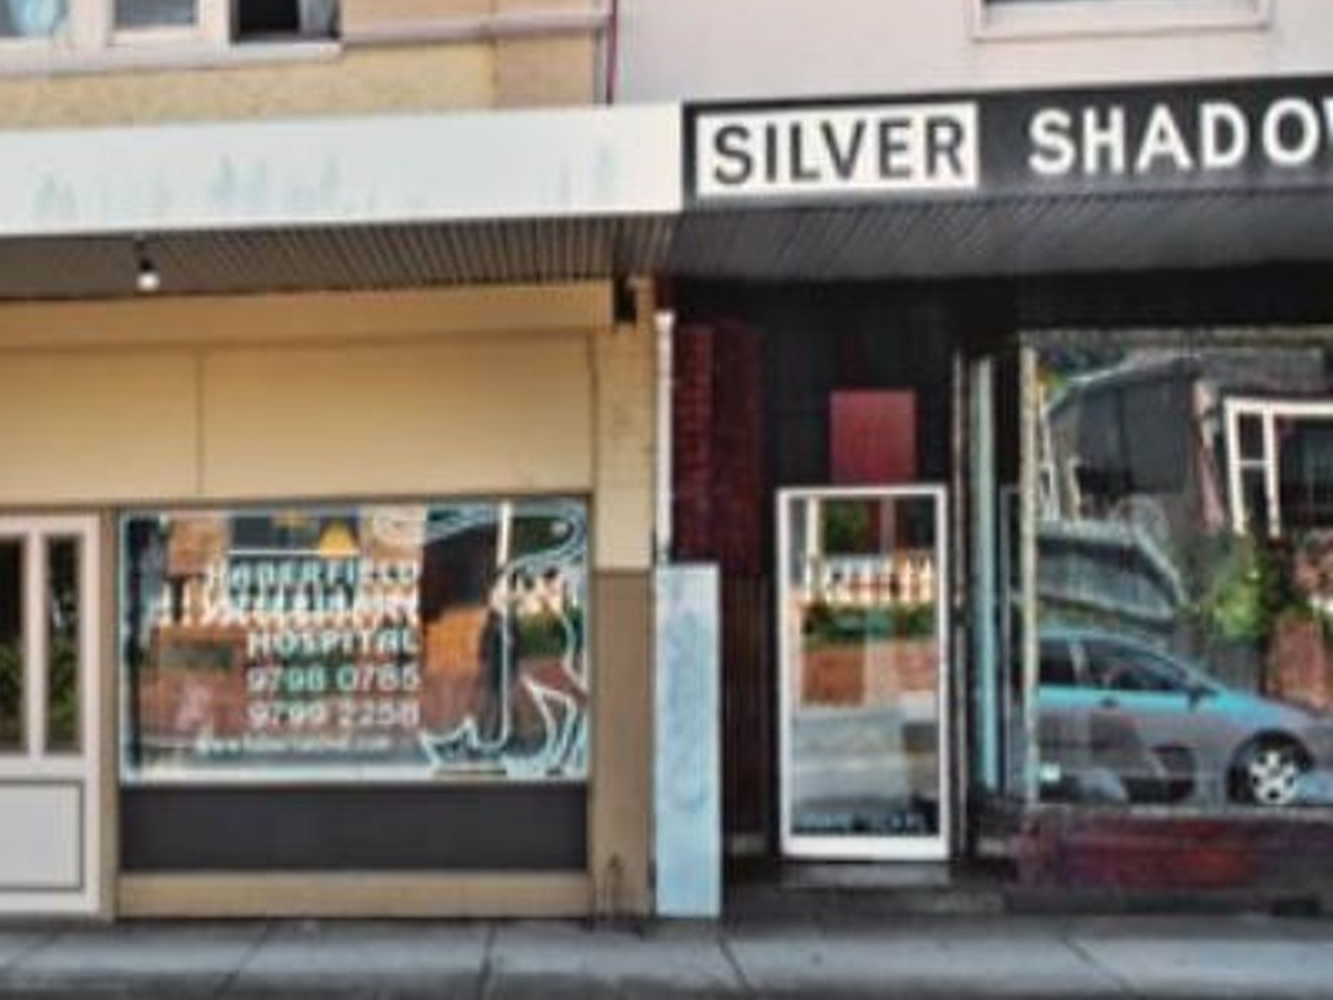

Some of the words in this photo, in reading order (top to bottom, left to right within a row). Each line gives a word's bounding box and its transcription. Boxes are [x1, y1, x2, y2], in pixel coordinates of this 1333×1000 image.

[712, 115, 966, 186] SILVER
[1027, 97, 1333, 175] SHADO
[246, 627, 422, 656] HOSPITAL
